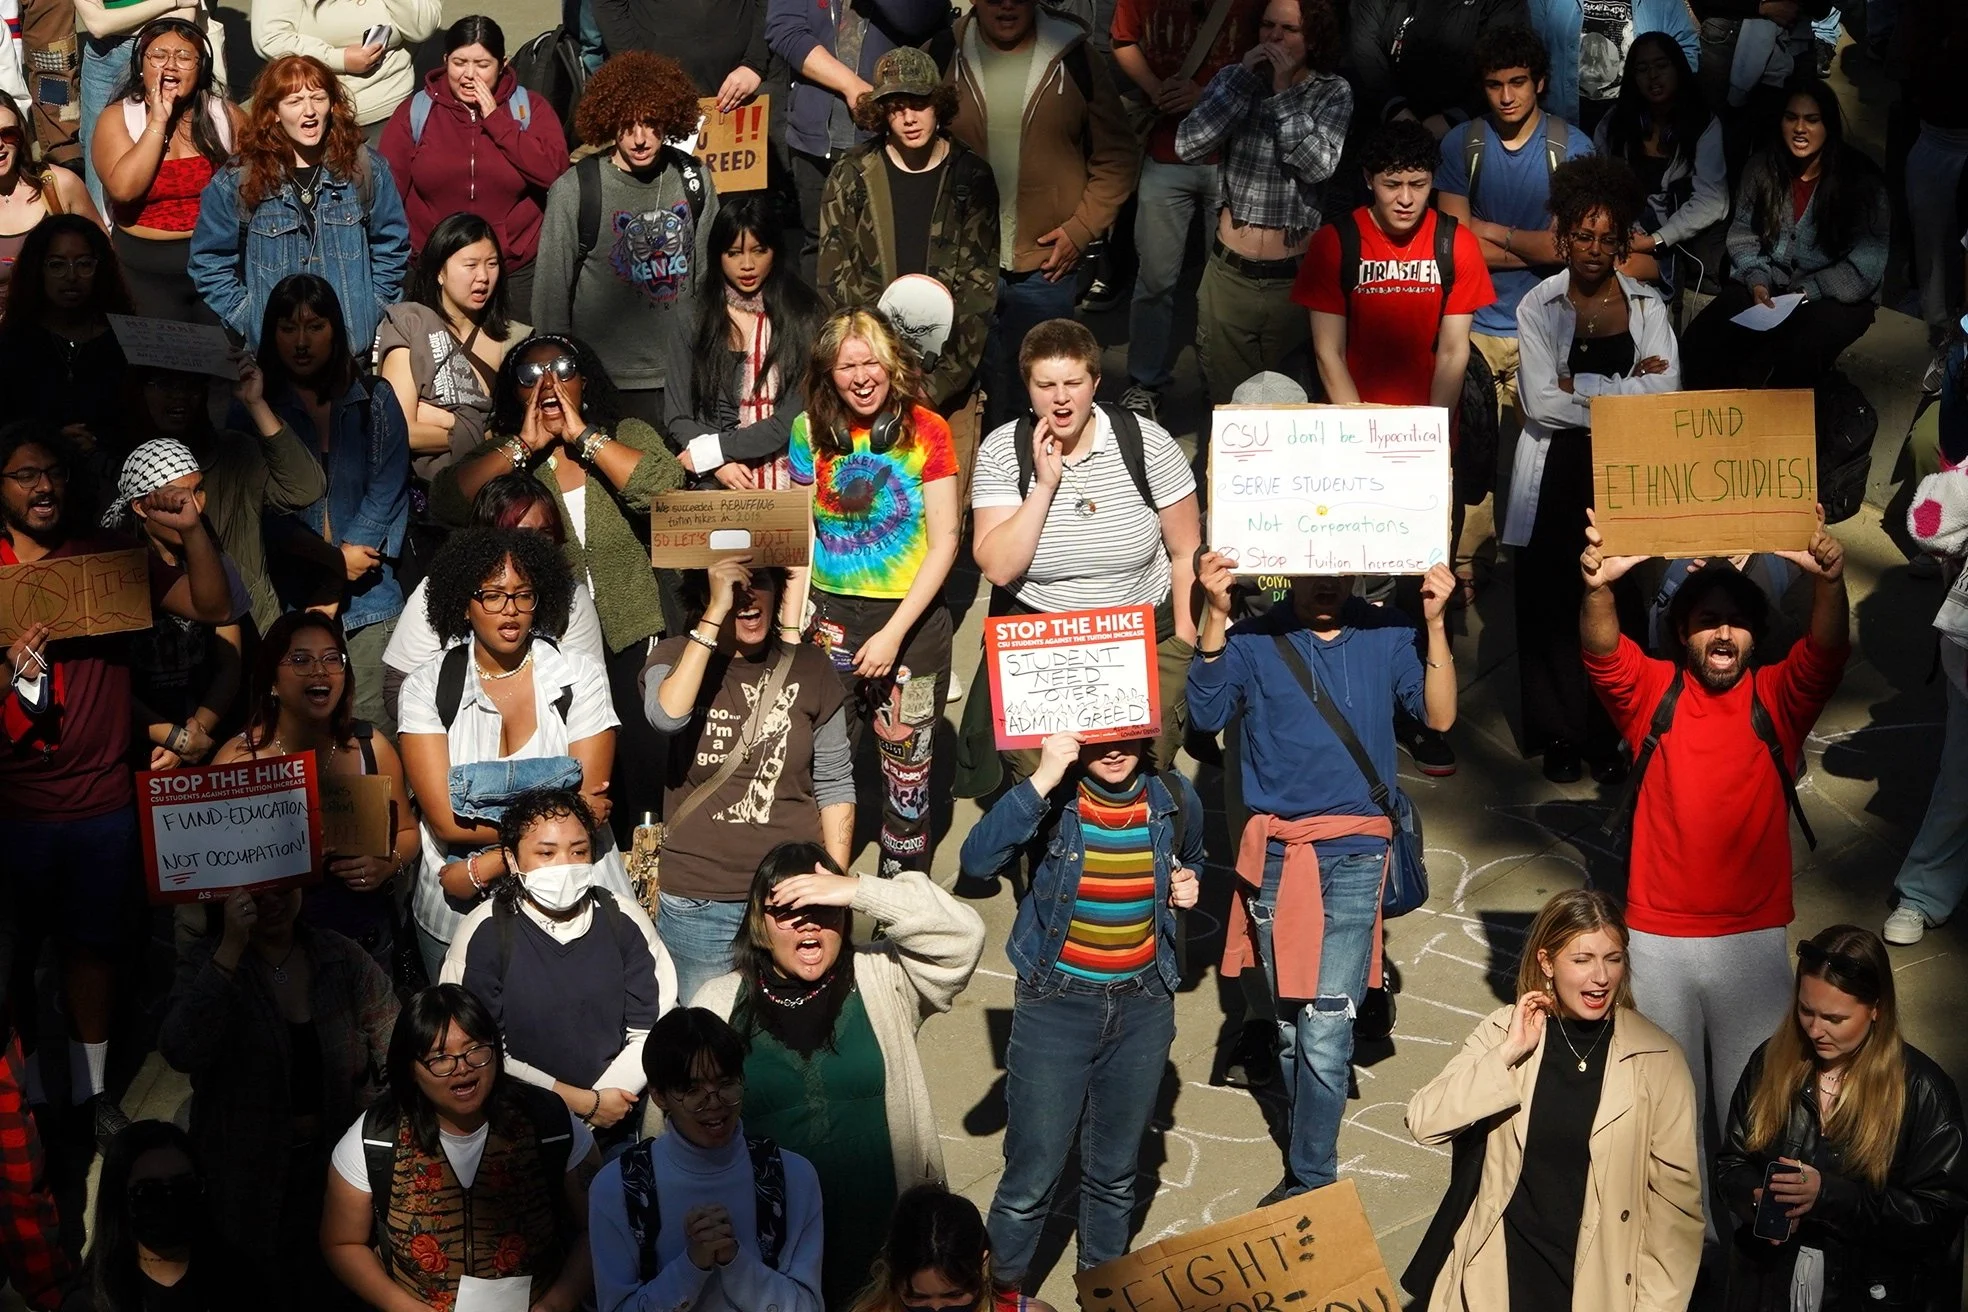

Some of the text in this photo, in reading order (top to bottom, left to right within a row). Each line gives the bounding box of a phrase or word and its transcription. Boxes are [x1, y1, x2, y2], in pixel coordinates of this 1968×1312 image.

[696, 131, 708, 151] U
[705, 149, 756, 173] REED
[631, 255, 688, 281] KENZO
[1221, 420, 1269, 448] CSU
[1287, 419, 1325, 445] don't
[1340, 421, 1363, 444] be
[1674, 407, 1744, 439] FUND
[1231, 475, 1385, 496] SERVE STUDENTS
[1605, 457, 1813, 509] ETHNIC STUDIES!
[655, 499, 775, 513] We succeeded REBUFFING
[694, 512, 717, 524] hikes
[1248, 512, 1410, 536] Not Corporations
[654, 528, 793, 548] SO LET'S DO IT
[1246, 540, 1427, 570] Stop tuition Increase
[73, 567, 147, 613] HIKE
[995, 611, 1145, 640] STOP THE HIKE
[997, 630, 1145, 649] CSU STUDENTS AGAINST THE TUITION INCREASE
[1006, 646, 1120, 676] STUDENT
[1034, 667, 1101, 688] NEED
[1045, 686, 1099, 702] OVER
[706, 722, 733, 738] I'm
[1009, 704, 1145, 734] ADMIN GREED
[712, 739, 724, 750] a
[697, 752, 729, 767] goa
[149, 759, 305, 796] STOP THE HIKE
[165, 793, 200, 802] STUDENTS
[201, 789, 231, 799] AGAINST
[231, 787, 245, 795] THE
[245, 784, 273, 793] TUITION
[273, 777, 307, 788] INCREASE
[162, 807, 223, 832] FUND
[162, 852, 200, 870] NOT
[206, 831, 306, 867] OCCUPATION!
[1122, 1232, 1289, 1312] FIGHT
